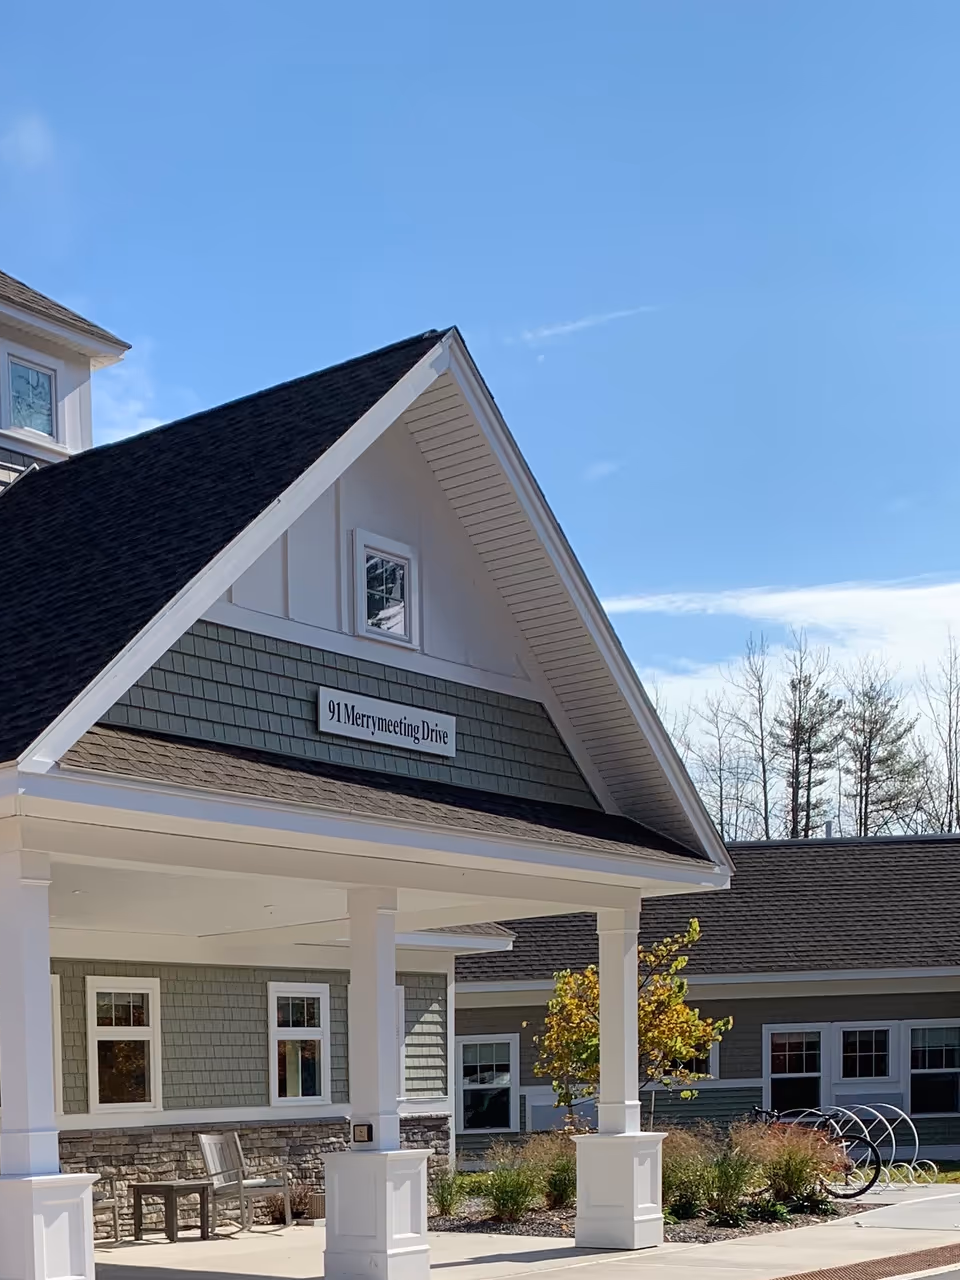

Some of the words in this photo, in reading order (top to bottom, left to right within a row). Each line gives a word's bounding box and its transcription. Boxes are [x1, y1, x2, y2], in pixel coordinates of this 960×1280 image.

[328, 699, 342, 723] 91
[343, 702, 420, 745] Merrymeeting
[421, 720, 449, 745] Drive
